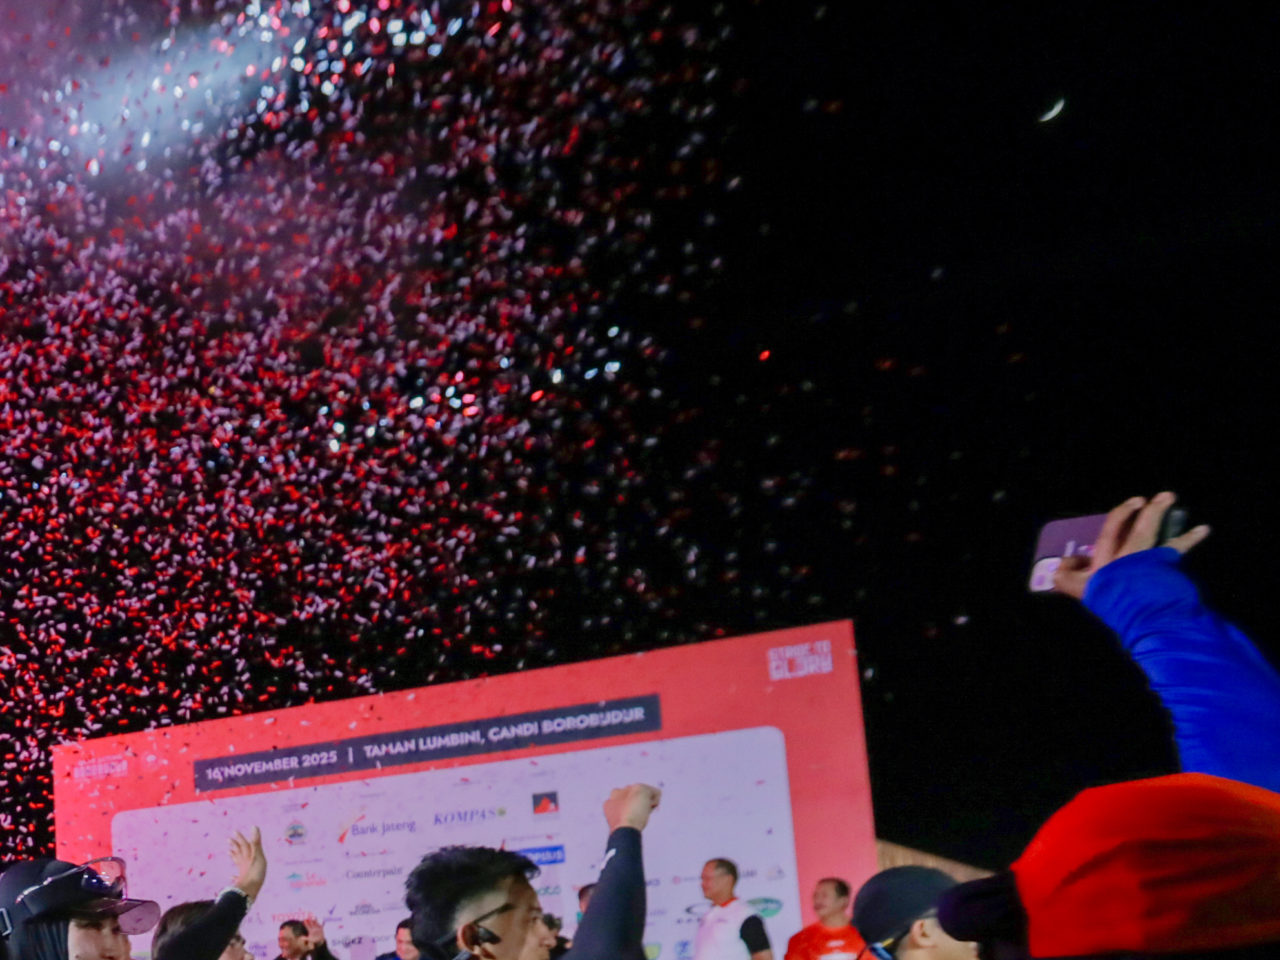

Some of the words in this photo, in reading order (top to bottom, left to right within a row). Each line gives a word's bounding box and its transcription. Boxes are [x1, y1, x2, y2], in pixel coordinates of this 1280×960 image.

[222, 756, 299, 778] NOVEMBER
[302, 750, 338, 767] 2025
[364, 738, 416, 758] TAMAN
[420, 730, 486, 751] LUMBINI,
[488, 721, 539, 741] CANDI
[542, 706, 645, 734] BOROBUDUR
[434, 809, 496, 826] KOMPAS
[351, 823, 378, 836] Bank
[382, 820, 416, 837] jateng
